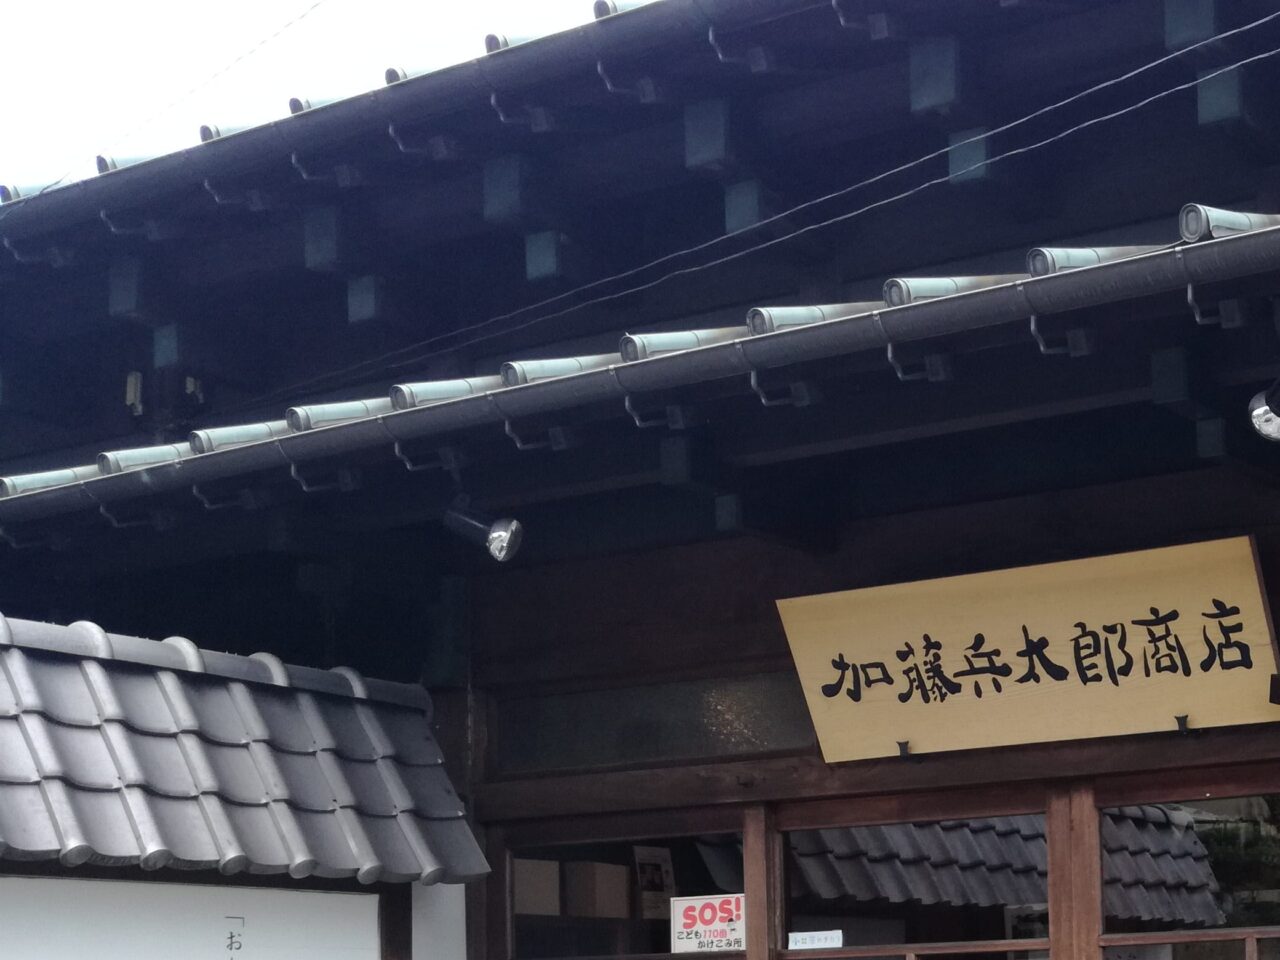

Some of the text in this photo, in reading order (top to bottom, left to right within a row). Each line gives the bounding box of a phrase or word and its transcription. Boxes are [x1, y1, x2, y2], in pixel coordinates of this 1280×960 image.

[822, 598, 1253, 703] 加藤兵太郎商店
[683, 896, 741, 929] SOS!
